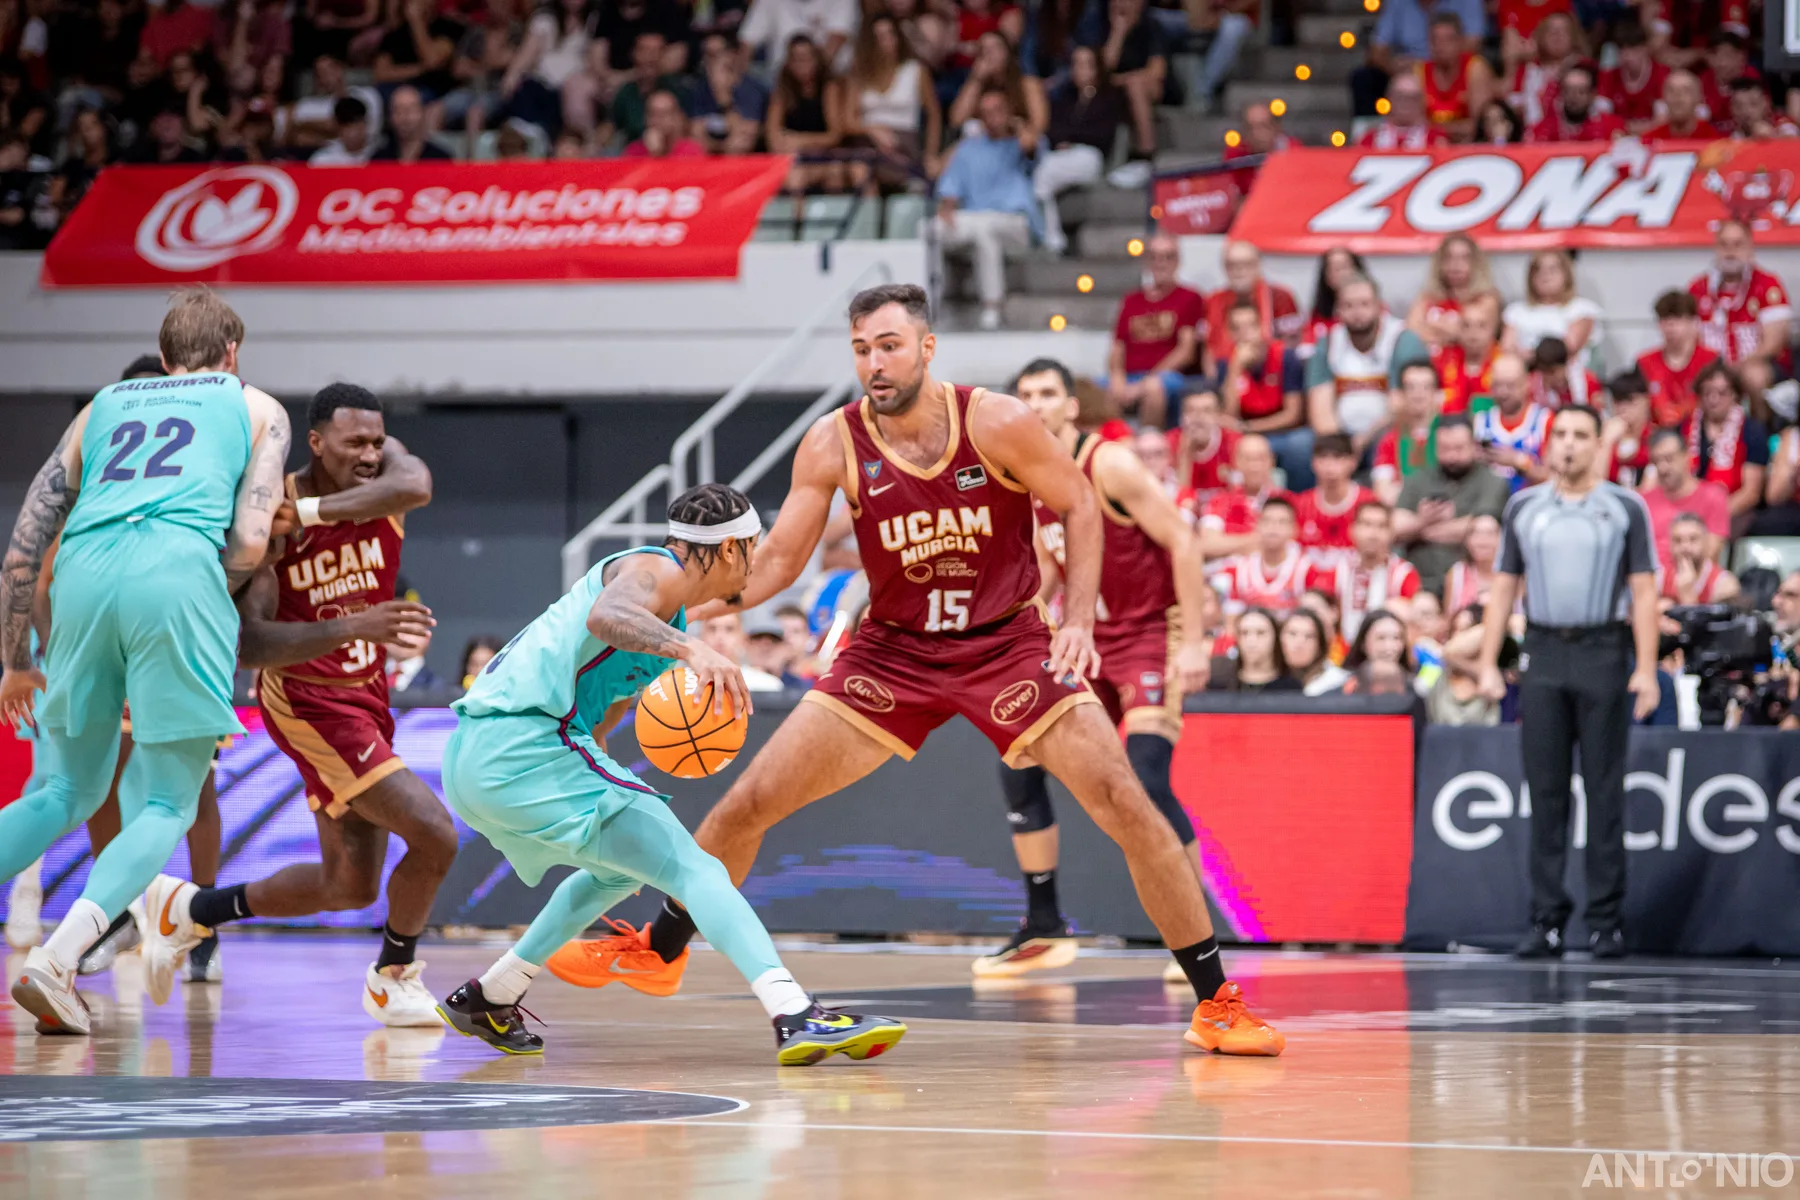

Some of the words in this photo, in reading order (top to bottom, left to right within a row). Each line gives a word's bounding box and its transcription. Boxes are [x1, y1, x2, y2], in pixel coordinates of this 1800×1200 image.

[317, 188, 403, 225] OC
[405, 183, 706, 224] Soluciones
[1308, 152, 1699, 233] ZONA
[298, 220, 689, 254] Medioambientales
[99, 416, 196, 484] 22
[878, 505, 993, 552] UCAM
[288, 536, 385, 591] UCAM
[900, 535, 980, 568] MURCIA
[308, 570, 379, 606] MURCIA
[924, 588, 973, 632] 15
[849, 680, 889, 707] Juver
[998, 686, 1033, 720] Juver
